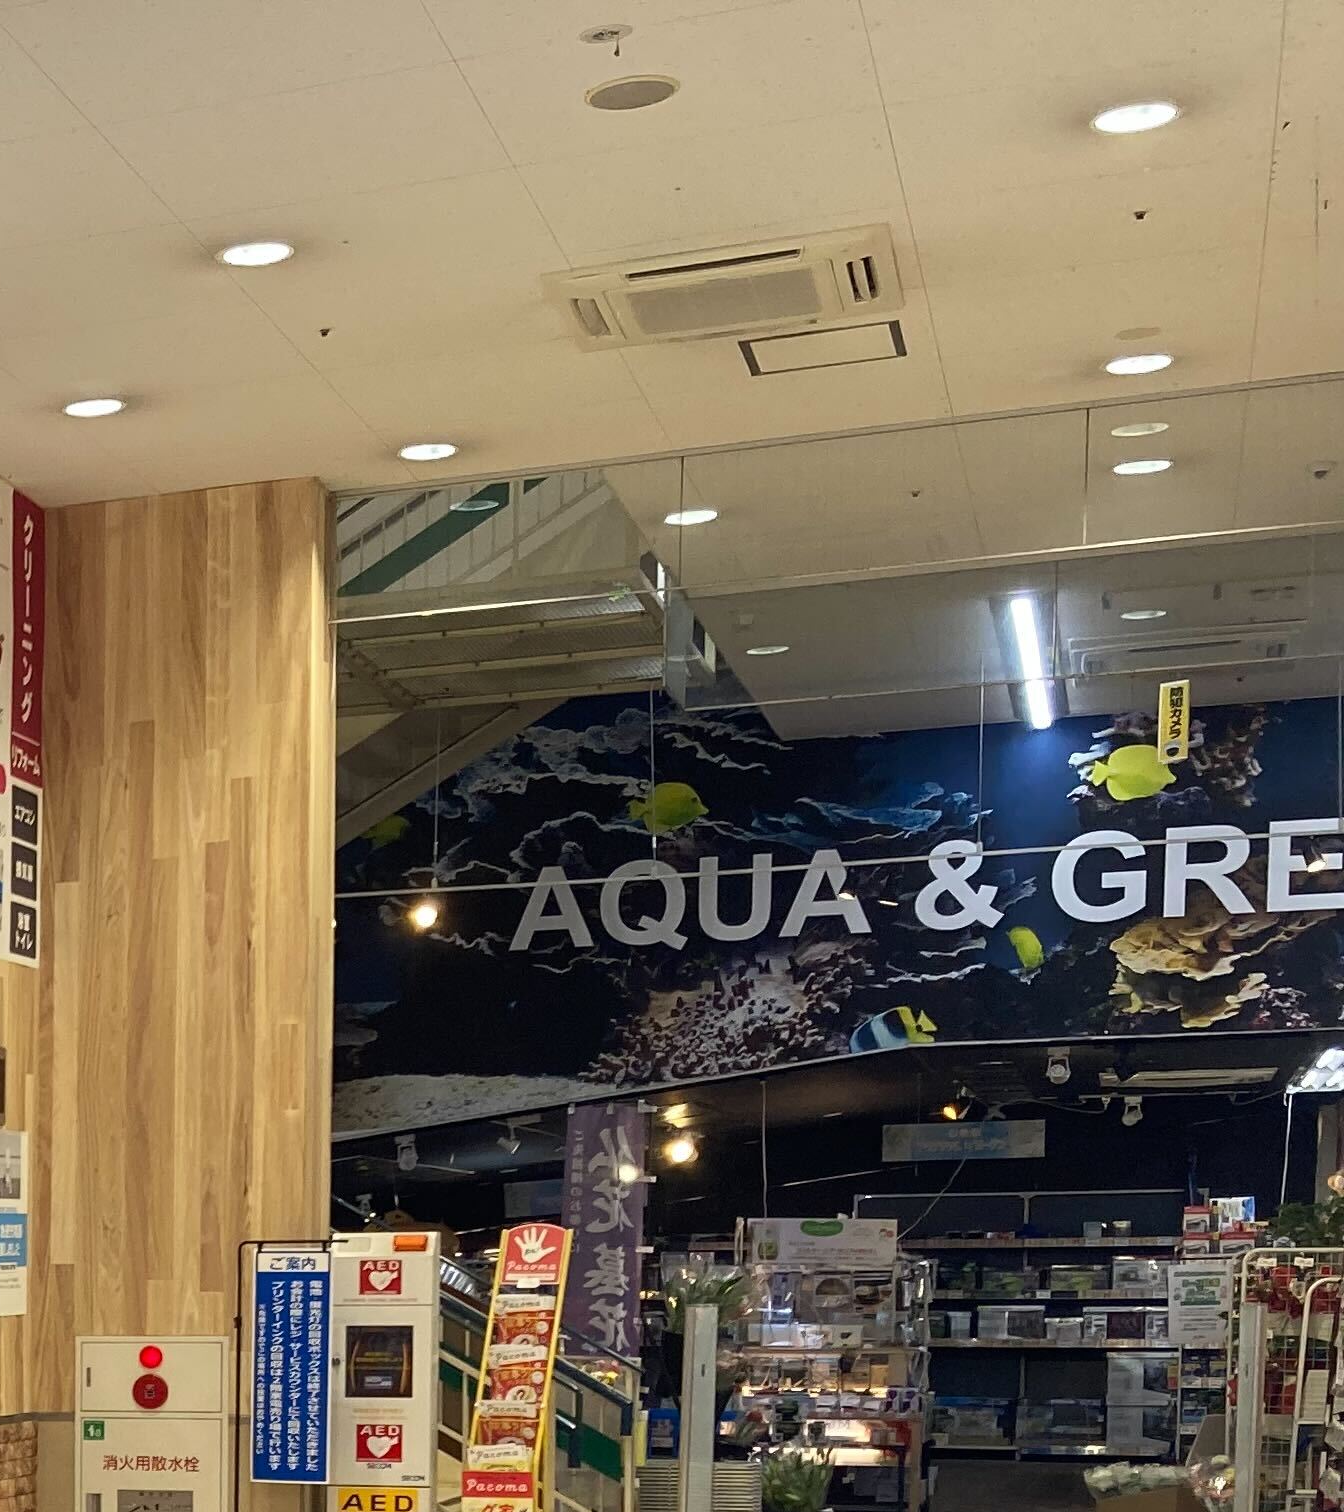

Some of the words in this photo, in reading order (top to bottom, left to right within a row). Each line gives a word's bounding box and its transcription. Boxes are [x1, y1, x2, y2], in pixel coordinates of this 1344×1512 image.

[20, 514, 36, 723] クリーニング
[1168, 686, 1184, 740] 防犯カメラ
[510, 848, 872, 953] AQUA
[914, 838, 1005, 932] &
[1050, 817, 1344, 924] GRE
[269, 1256, 317, 1272] ご案内
[363, 1260, 400, 1271] AED
[360, 1425, 400, 1436] AED
[102, 1454, 201, 1473] 消火用散水栓
[466, 1478, 529, 1493] Pacoma
[341, 1494, 414, 1512] AED
